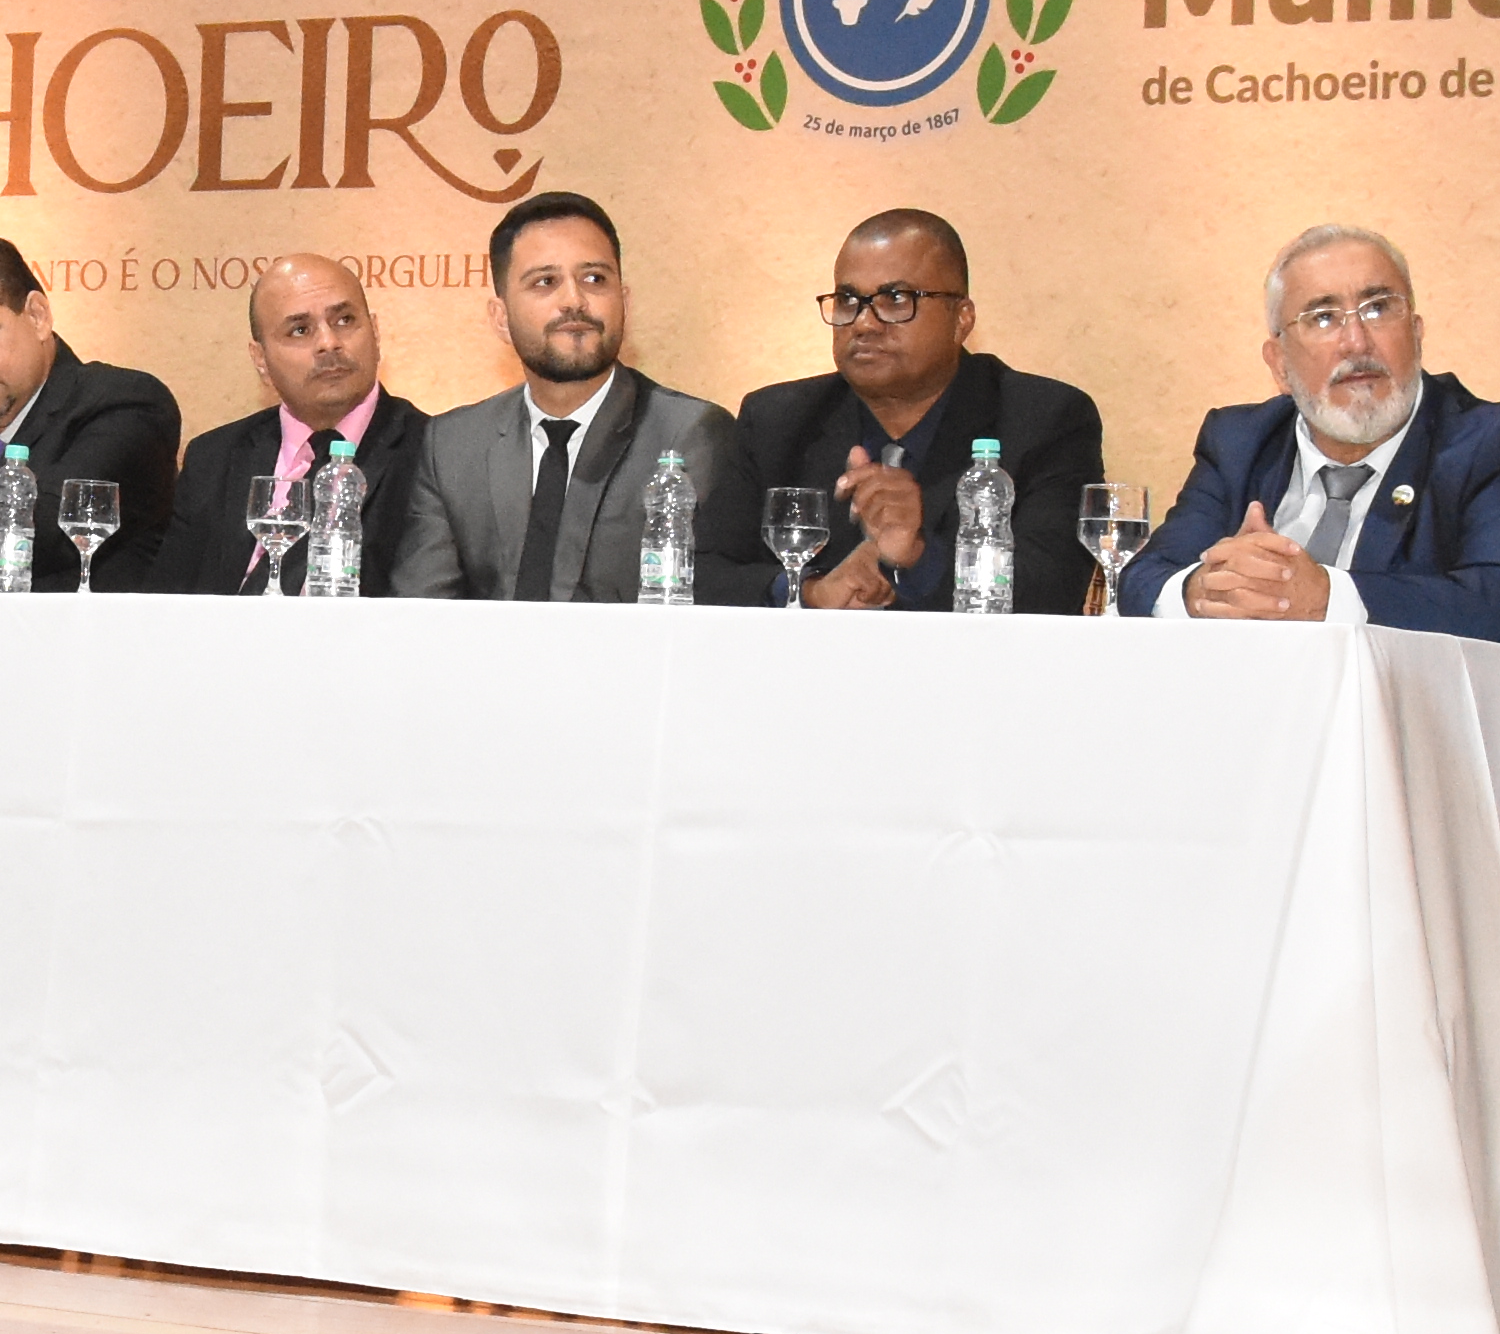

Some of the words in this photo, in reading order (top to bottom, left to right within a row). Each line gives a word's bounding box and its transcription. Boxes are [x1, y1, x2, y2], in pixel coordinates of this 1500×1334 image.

[1141, 65, 1193, 105] de
[1206, 60, 1427, 104] Cachoeiro
[1440, 57, 1495, 98] de
[803, 114, 822, 132] 25
[825, 120, 845, 136] de
[849, 125, 898, 143] março
[902, 121, 922, 136] de
[926, 108, 960, 131] 1867
[120, 247, 139, 291] É
[151, 259, 181, 290] O
[338, 253, 490, 289] ORGULH
